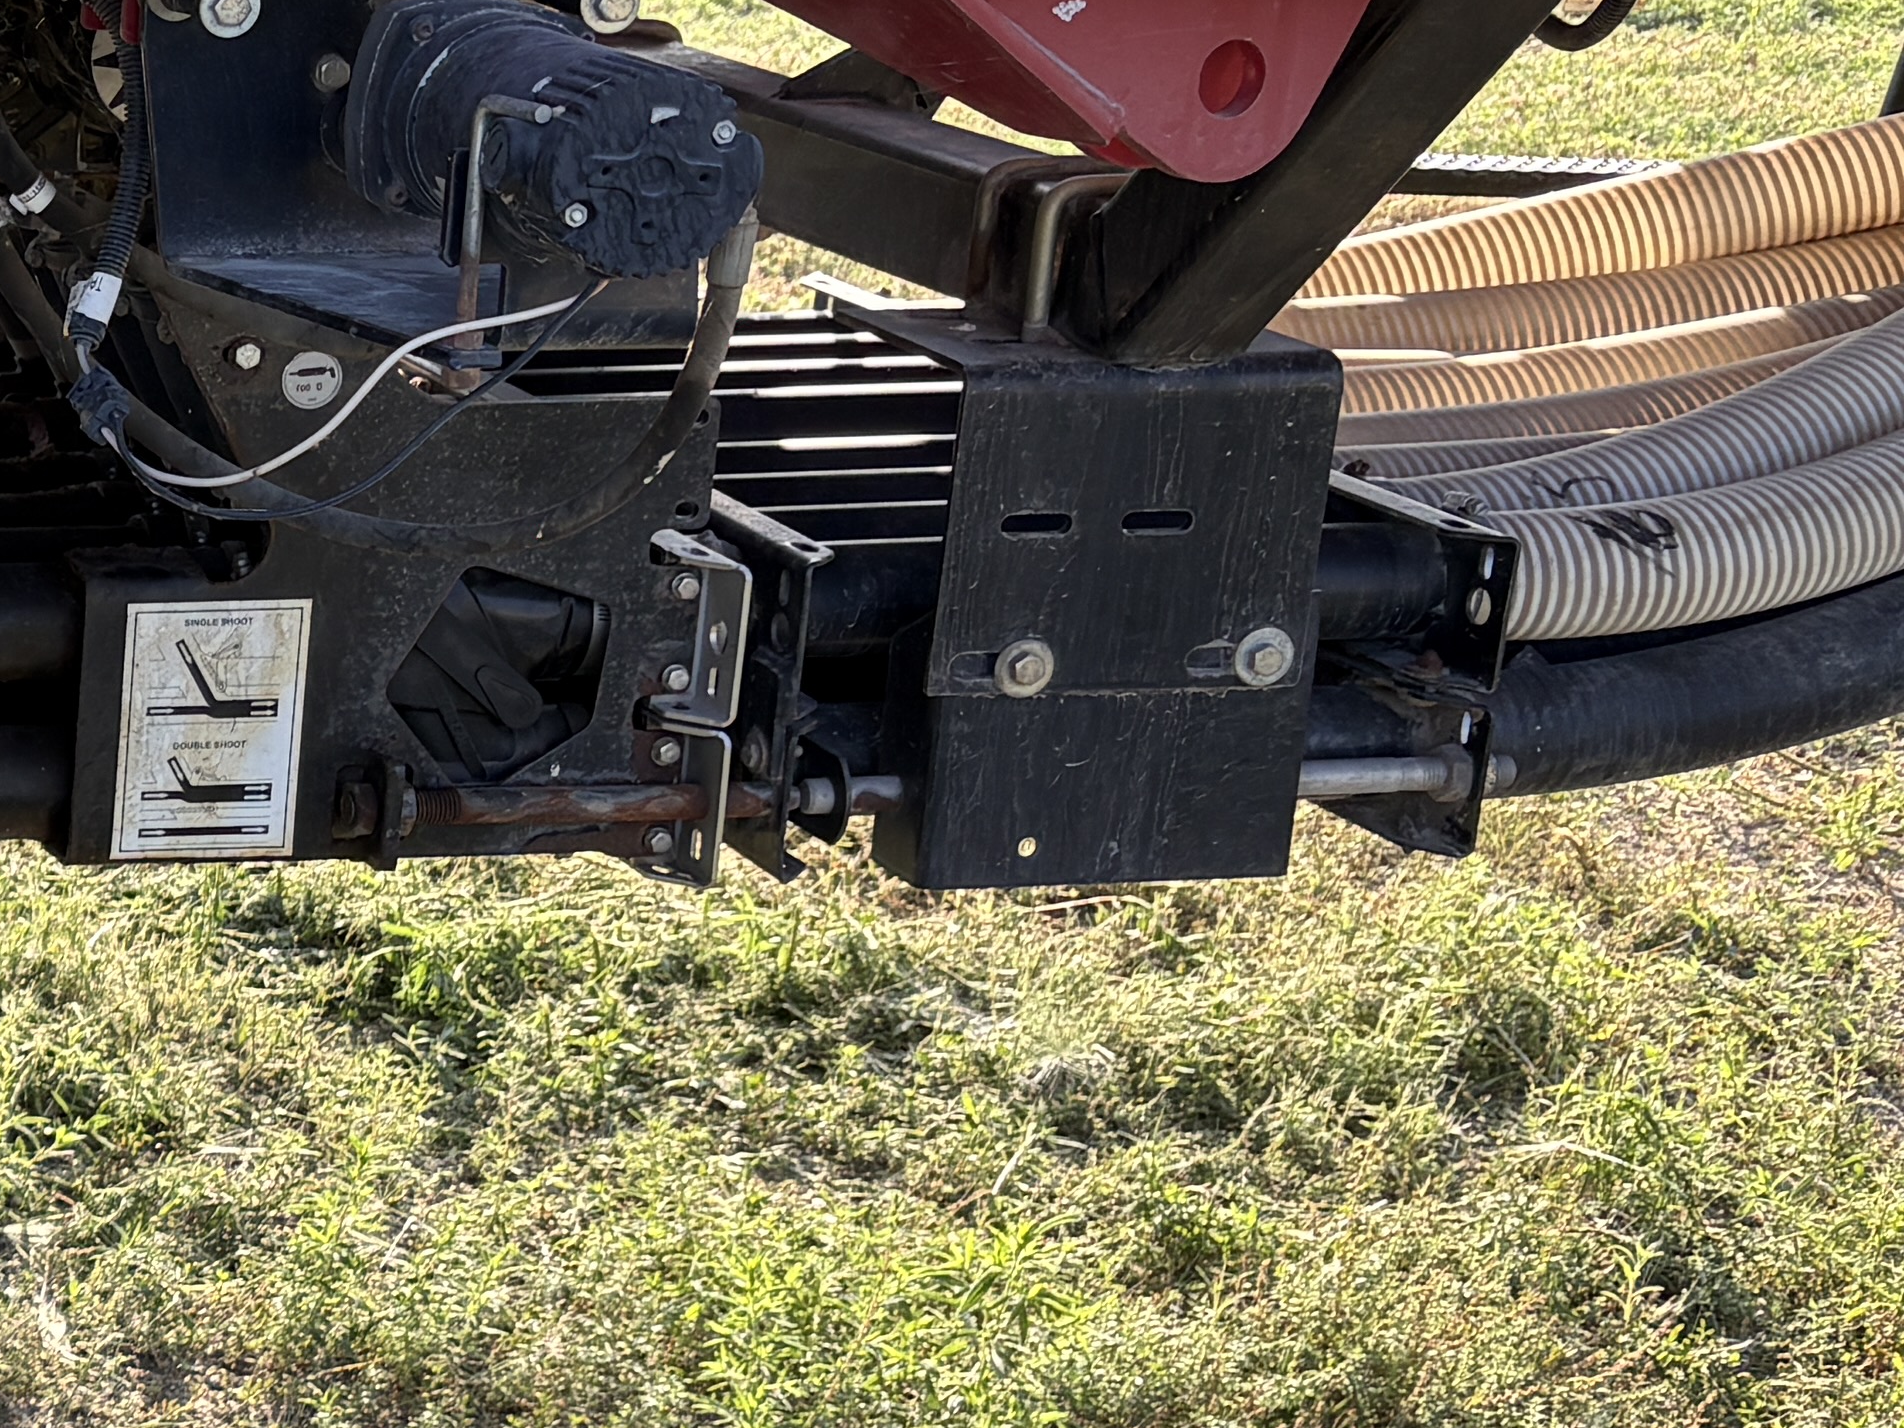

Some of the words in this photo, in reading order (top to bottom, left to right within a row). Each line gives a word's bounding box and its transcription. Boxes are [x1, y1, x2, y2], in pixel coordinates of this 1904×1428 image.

[221, 617, 254, 626] SHOOT
[173, 741, 212, 750] DOUBLE
[214, 740, 247, 749] SHOOT
